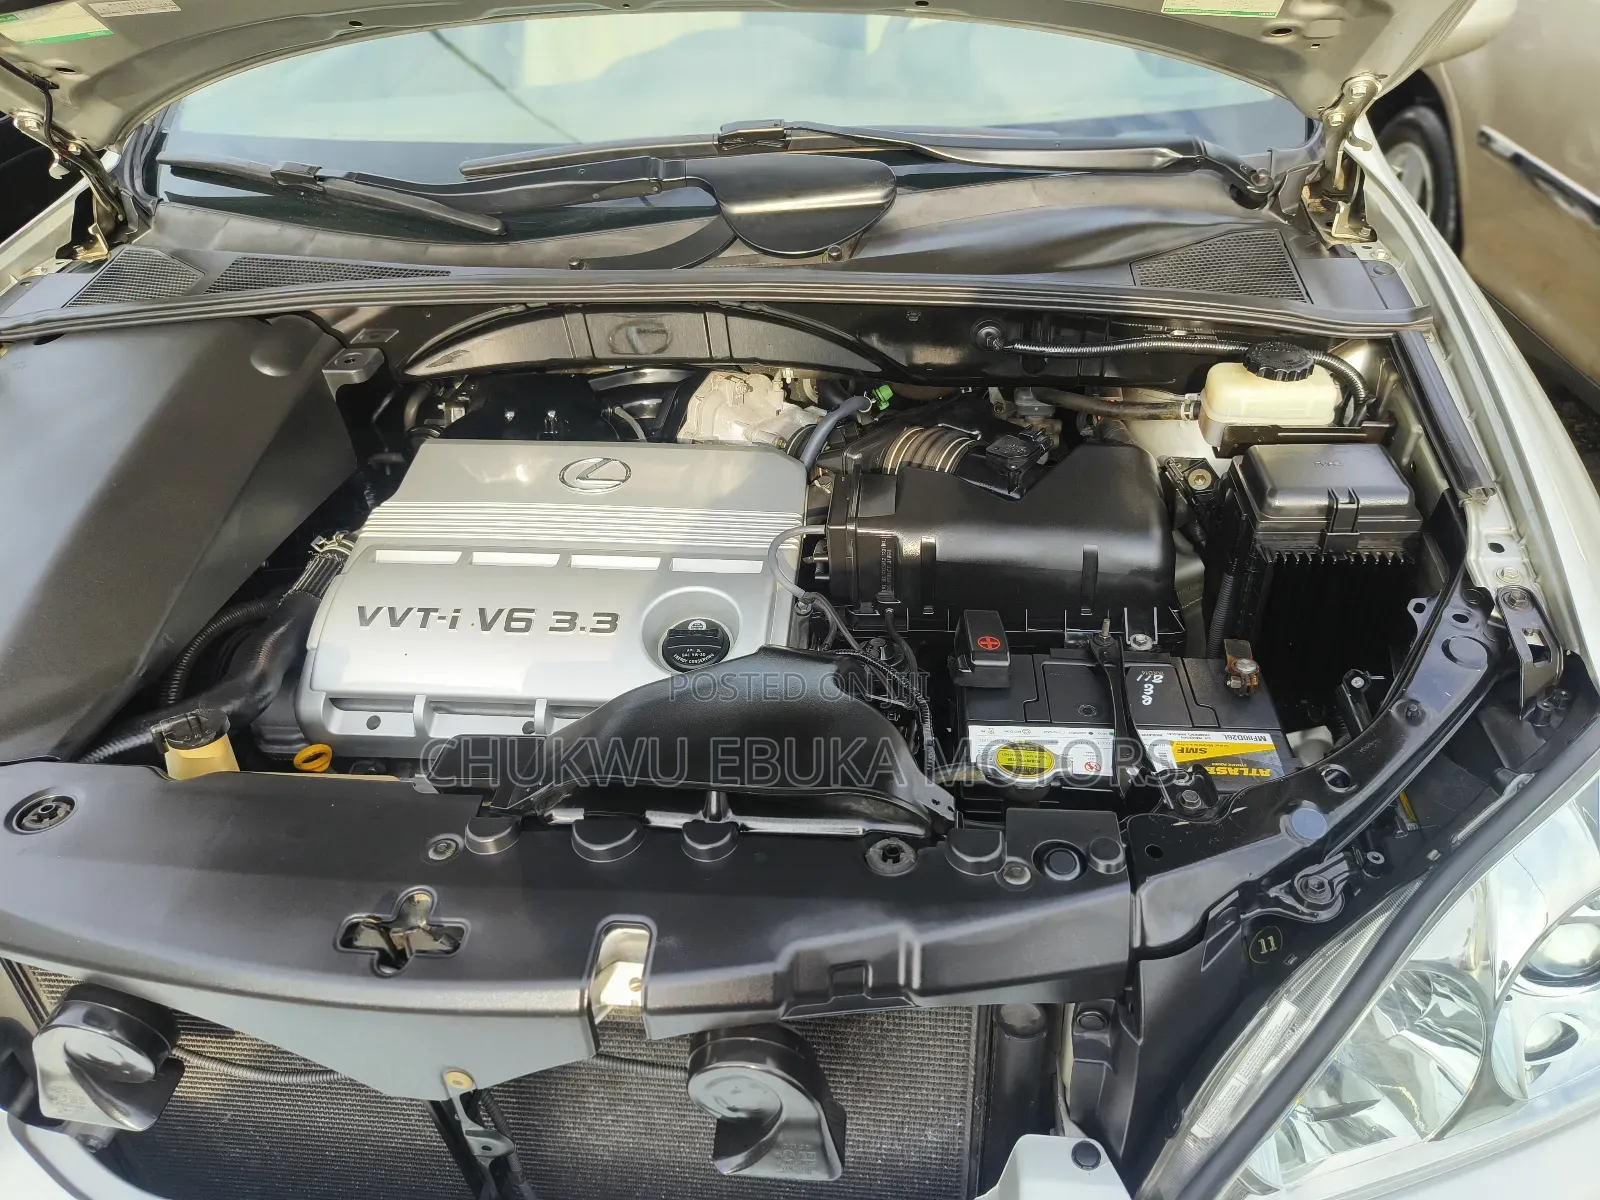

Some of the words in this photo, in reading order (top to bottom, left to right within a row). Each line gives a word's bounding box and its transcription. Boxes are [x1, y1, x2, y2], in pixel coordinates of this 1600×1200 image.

[357, 605, 462, 632] VVT-i
[478, 607, 537, 635] V6
[548, 610, 621, 636] 3.3
[1177, 747, 1208, 755] SMF
